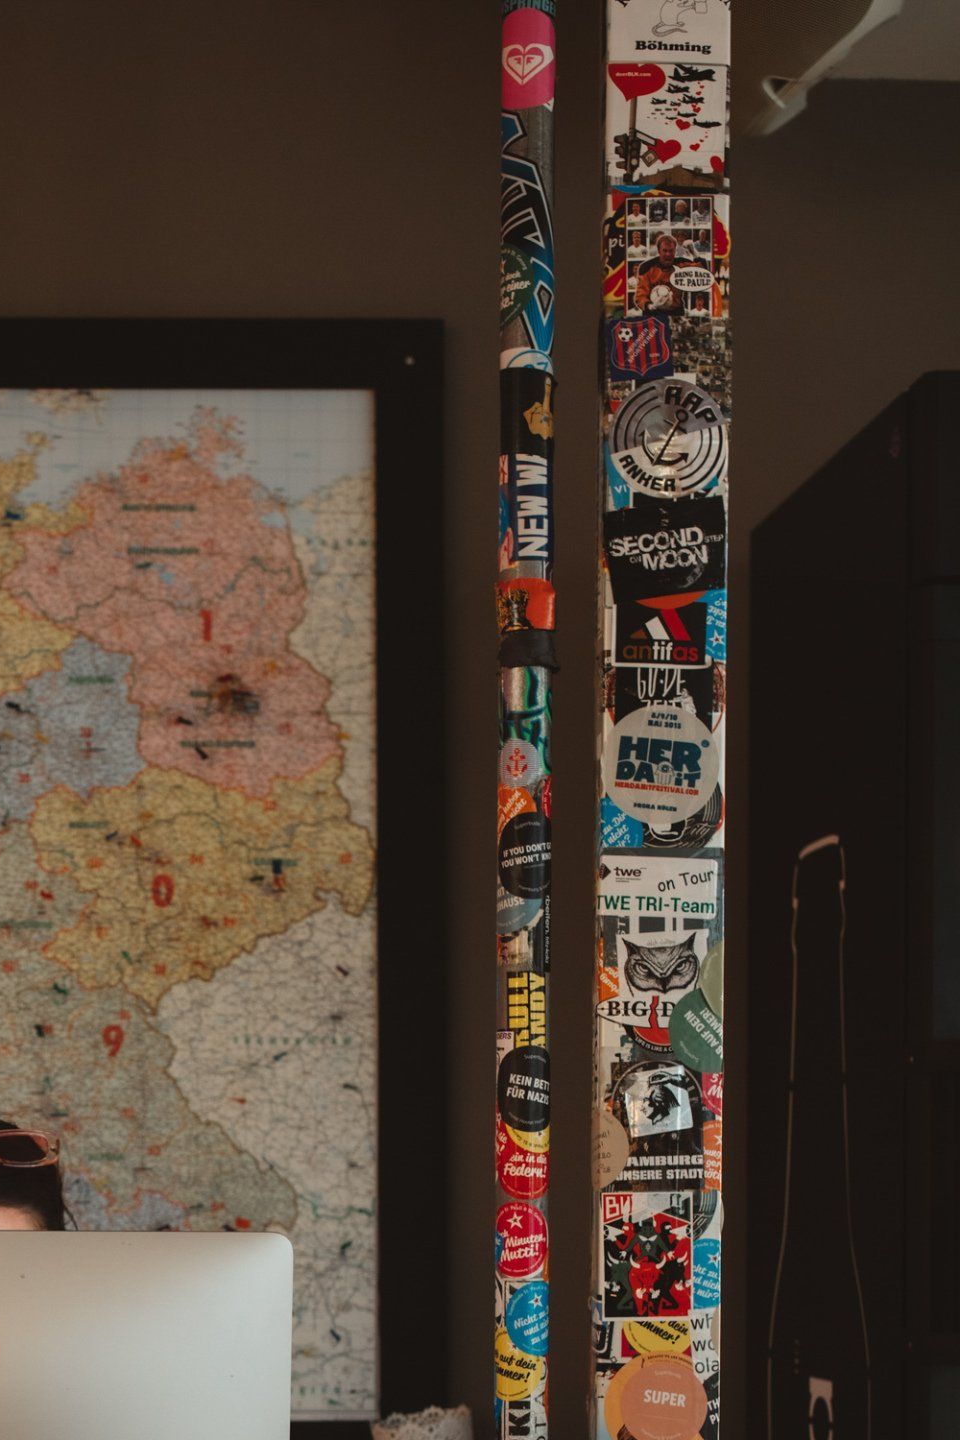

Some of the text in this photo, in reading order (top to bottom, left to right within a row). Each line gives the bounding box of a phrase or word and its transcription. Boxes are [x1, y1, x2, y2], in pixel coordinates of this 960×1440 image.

[635, 40, 712, 55] Böhming
[618, 453, 677, 492] ANKER
[516, 495, 549, 558] NEW
[609, 526, 724, 558] SECOND STEP
[640, 546, 708, 571] MOON
[200, 609, 212, 643] 1
[622, 641, 699, 662] antifas
[618, 735, 702, 773] HER
[509, 845, 525, 856] YOU
[613, 865, 642, 878] twe
[657, 869, 715, 893] on Tour
[151, 873, 176, 909] 0
[597, 895, 716, 914] TWE TRI-Team
[607, 1000, 649, 1018] BIG
[683, 1010, 717, 1048] AUF DEIN
[101, 1023, 126, 1058] 9
[509, 1073, 550, 1092] KEIN BETT
[506, 1085, 549, 1104] FÜR NAZIS
[503, 1162, 546, 1178] Federn!
[626, 1154, 703, 1167] AMBURG
[666, 1168, 703, 1180] STADT
[501, 1244, 540, 1261] Mutti!
[514, 1313, 531, 1328] Nicht
[499, 1353, 537, 1371] auf dein
[643, 1389, 687, 1407] SUPER
